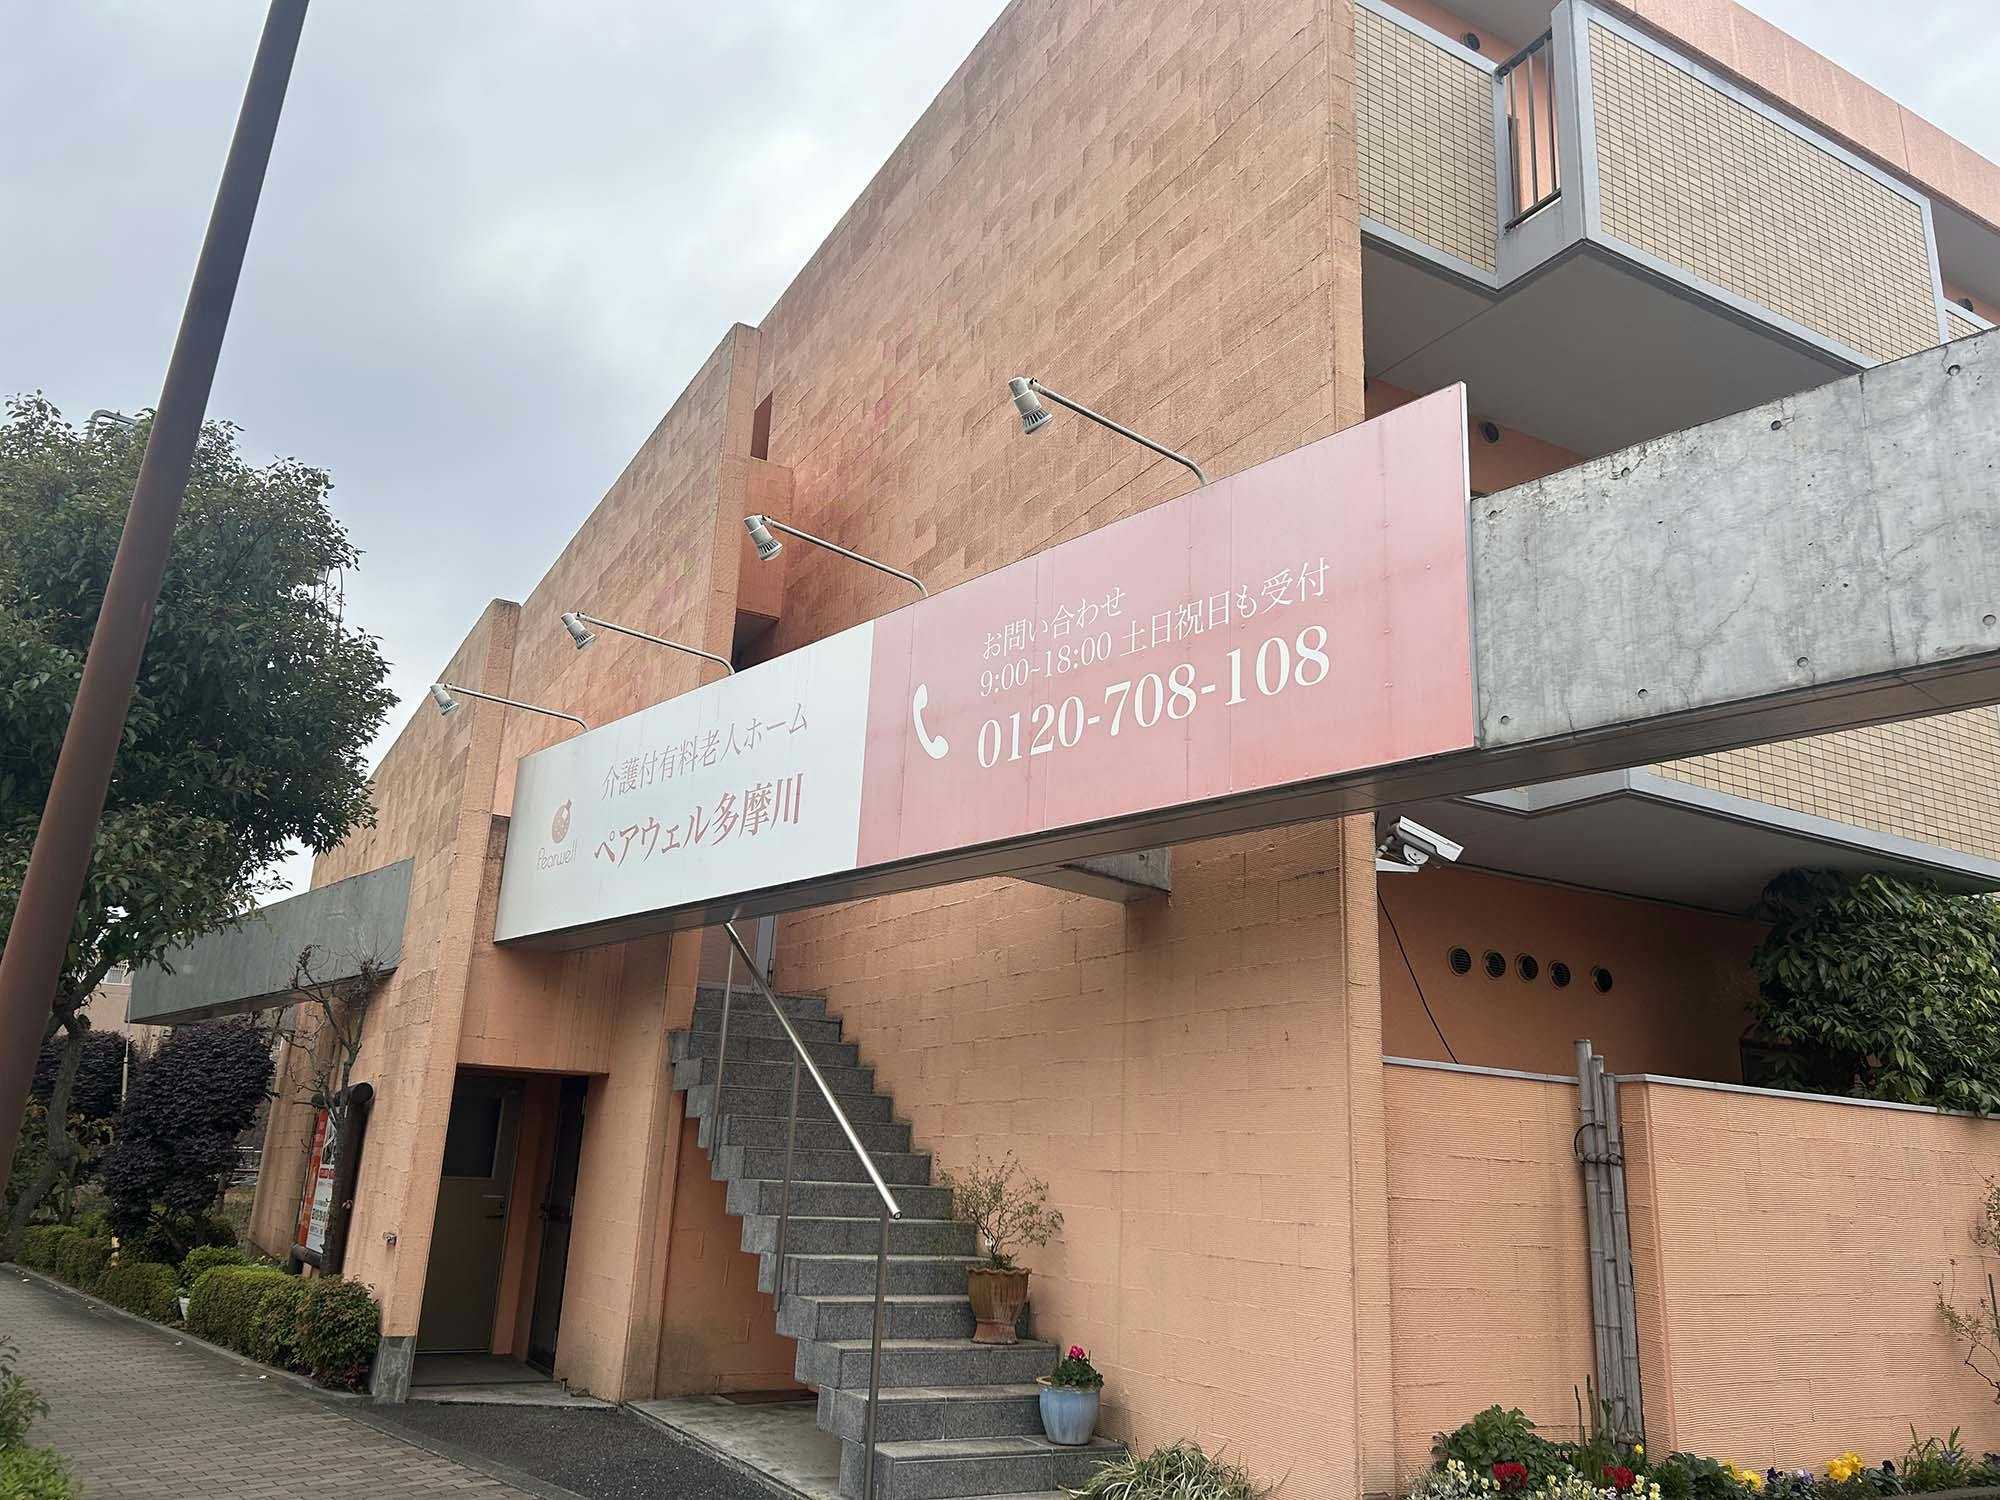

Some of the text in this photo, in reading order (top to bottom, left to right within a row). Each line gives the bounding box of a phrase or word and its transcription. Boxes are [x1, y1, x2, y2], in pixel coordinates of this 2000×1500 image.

[982, 586, 1127, 660] お問い合わせ
[1119, 556, 1330, 657] 土日祝日も受付
[976, 624, 1331, 769] 0120-708-108
[601, 702, 808, 801] 介護付有料老人ホーム
[593, 772, 804, 869] ペアウェル多摩川
